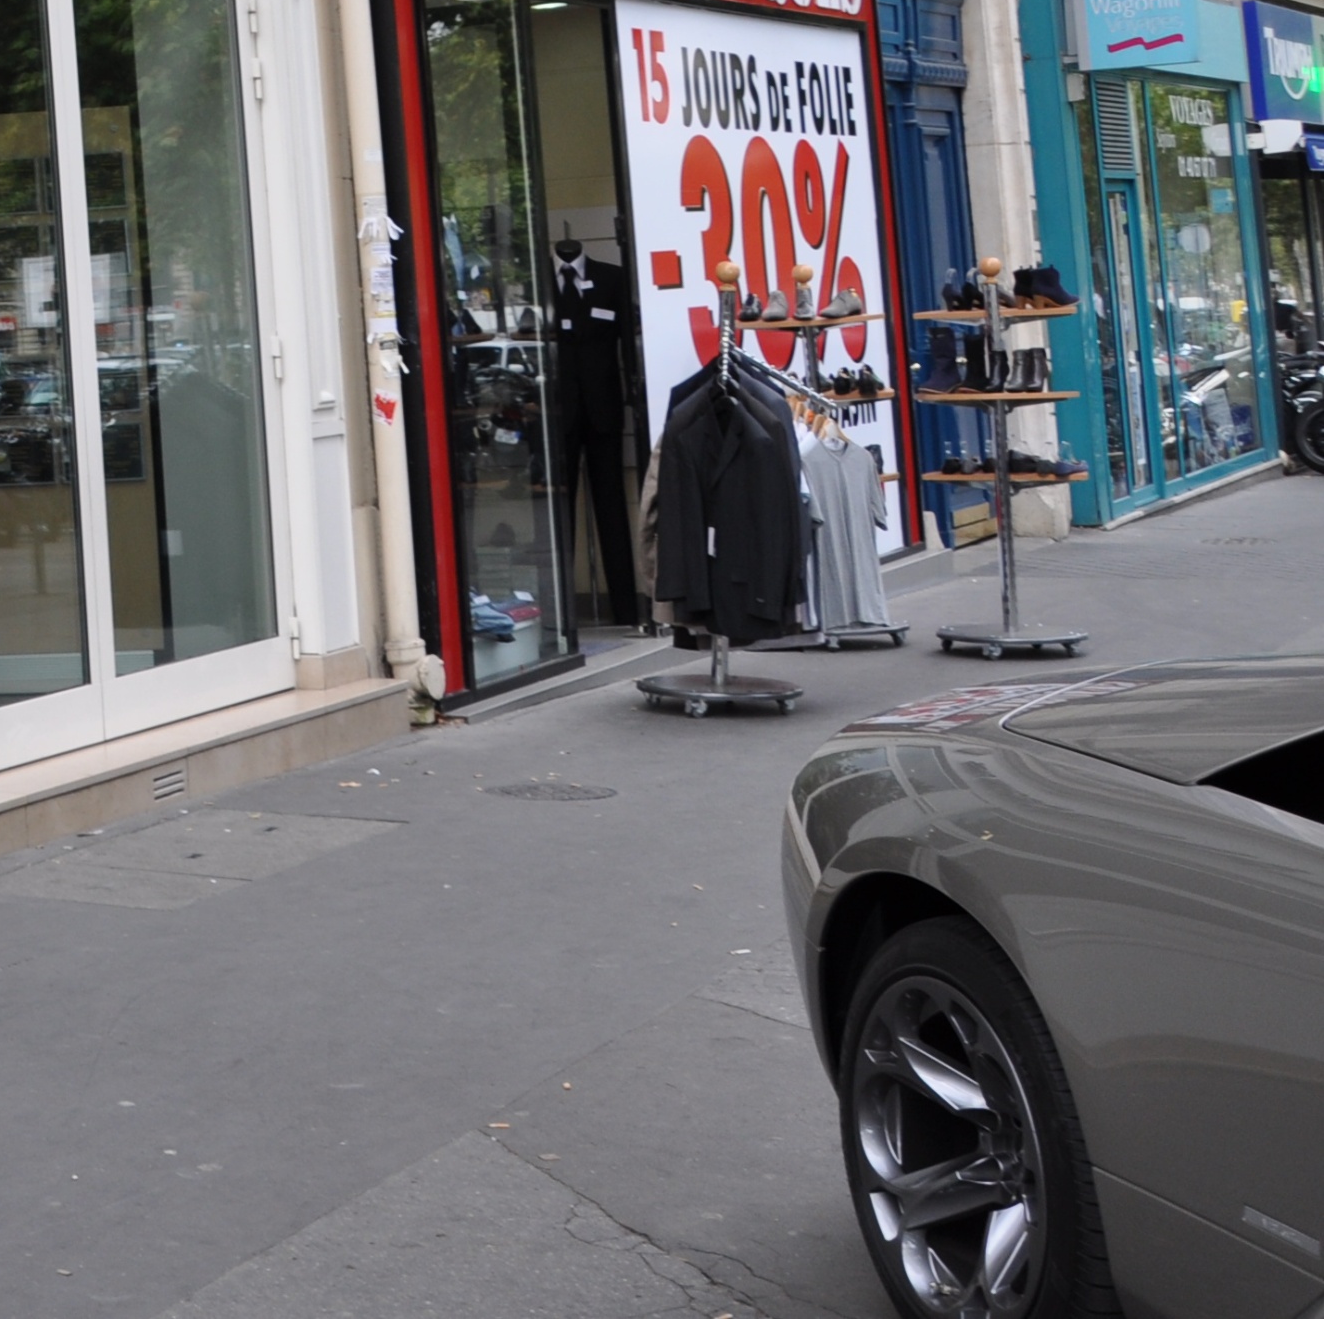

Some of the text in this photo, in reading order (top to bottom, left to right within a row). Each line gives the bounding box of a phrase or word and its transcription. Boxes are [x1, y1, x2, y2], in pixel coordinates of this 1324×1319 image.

[631, 27, 858, 137] 15 JOURS DE FOLIE
[650, 134, 867, 371] -30%
